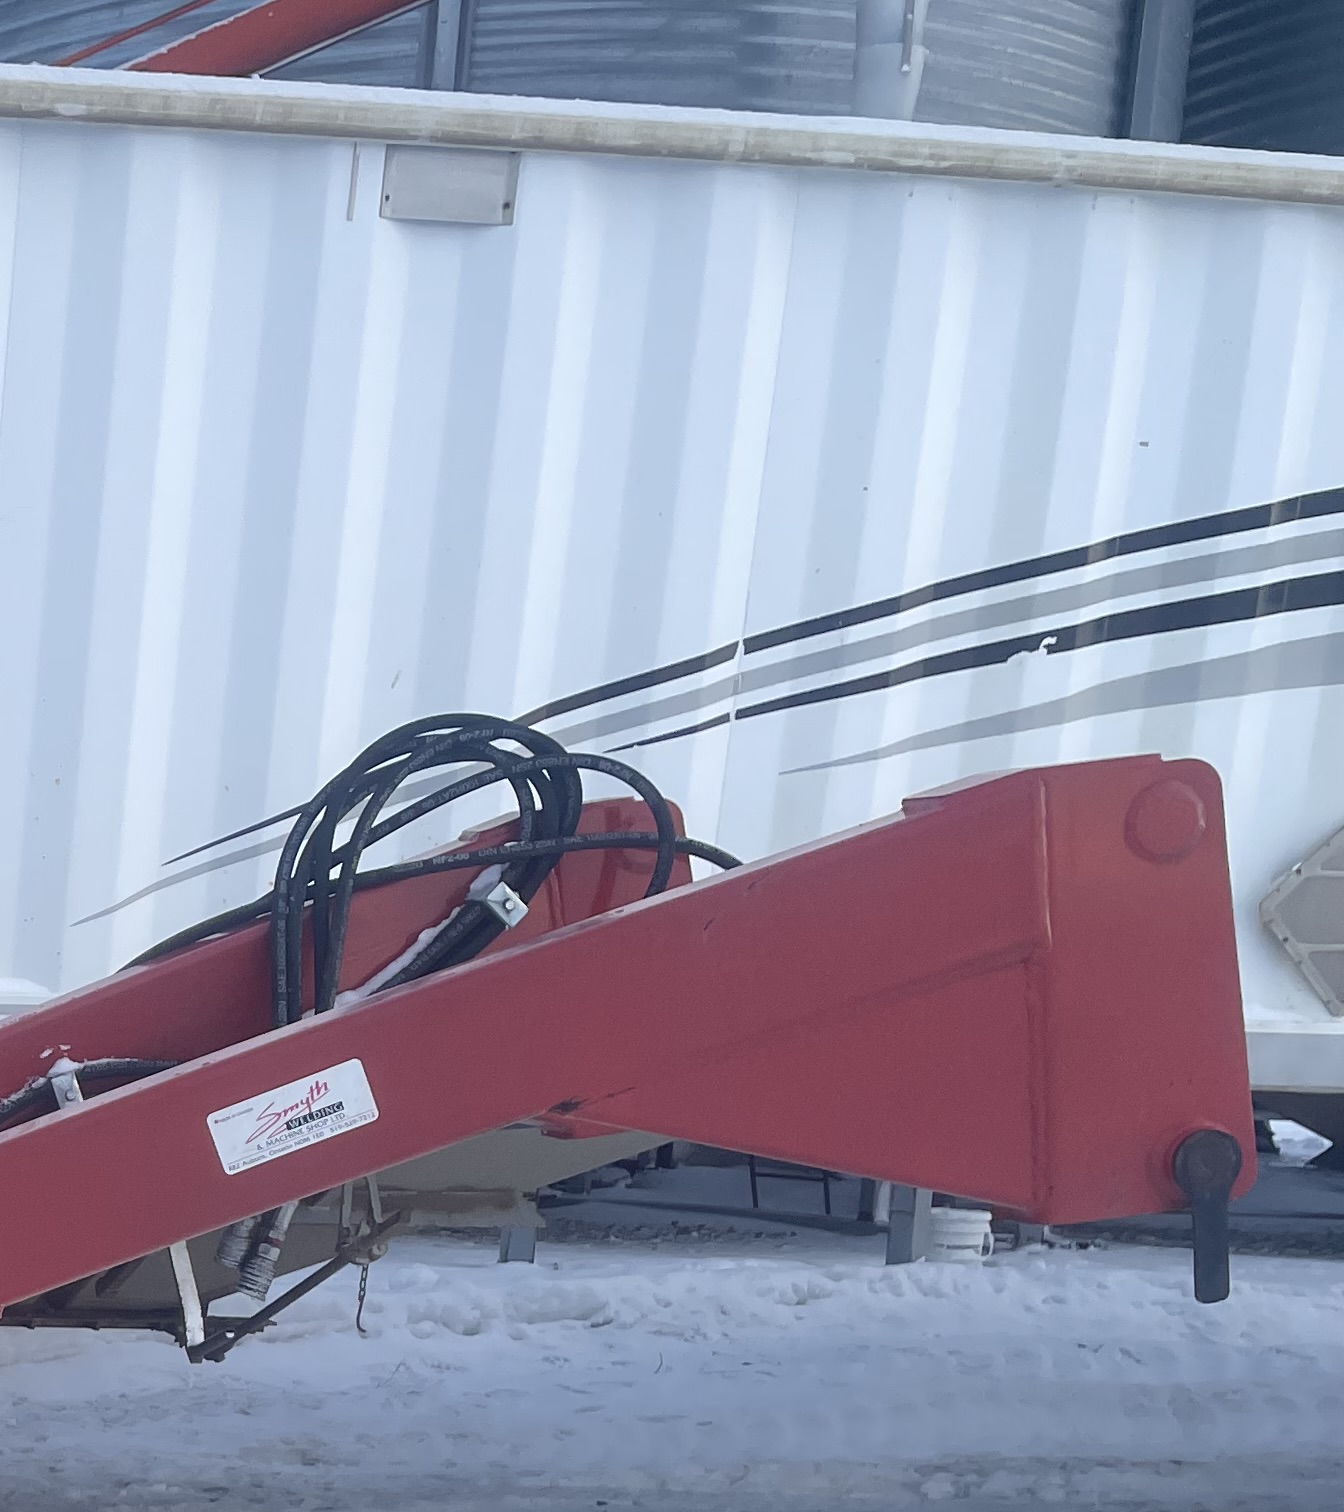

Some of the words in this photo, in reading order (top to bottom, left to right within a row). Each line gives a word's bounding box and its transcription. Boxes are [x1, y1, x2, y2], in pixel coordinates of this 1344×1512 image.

[246, 1080, 330, 1144] Smyth
[286, 1101, 344, 1130] WELDING
[265, 1128, 304, 1148] MACHINE
[305, 1118, 329, 1134] SHOP
